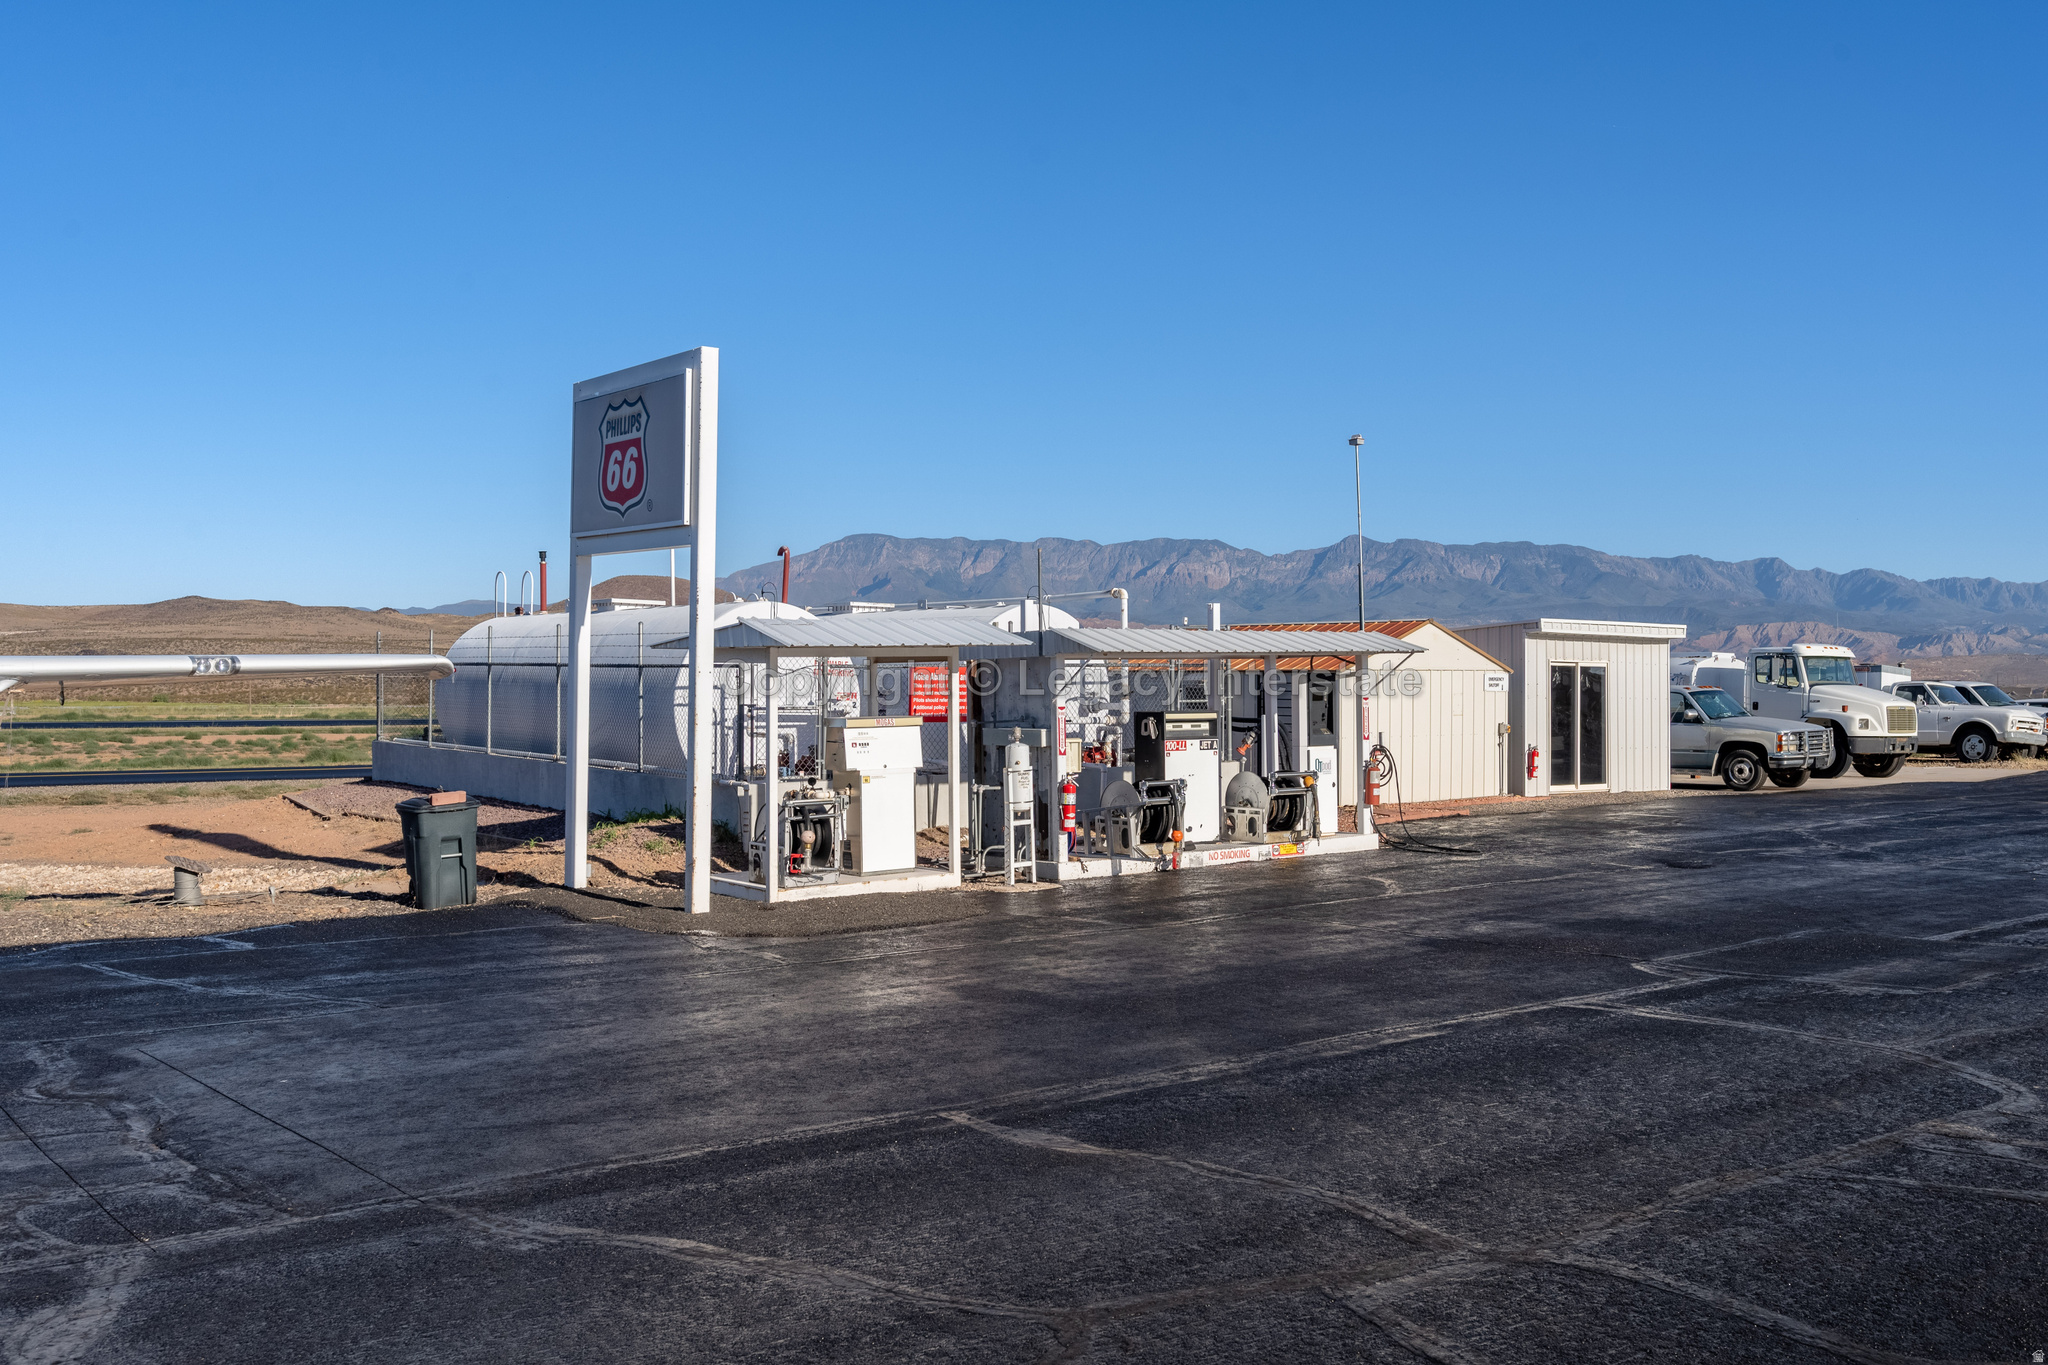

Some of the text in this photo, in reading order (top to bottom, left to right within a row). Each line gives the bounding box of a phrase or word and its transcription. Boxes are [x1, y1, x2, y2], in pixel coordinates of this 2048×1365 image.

[605, 413, 642, 439] PHILLIPS
[606, 446, 638, 492] 66
[852, 701, 857, 709] 2
[875, 718, 895, 726] MOGAS
[1166, 741, 1186, 751] 100-LL
[1200, 740, 1219, 750] JET A
[1208, 851, 1219, 860] NO
[1219, 849, 1251, 860] SMOKING
